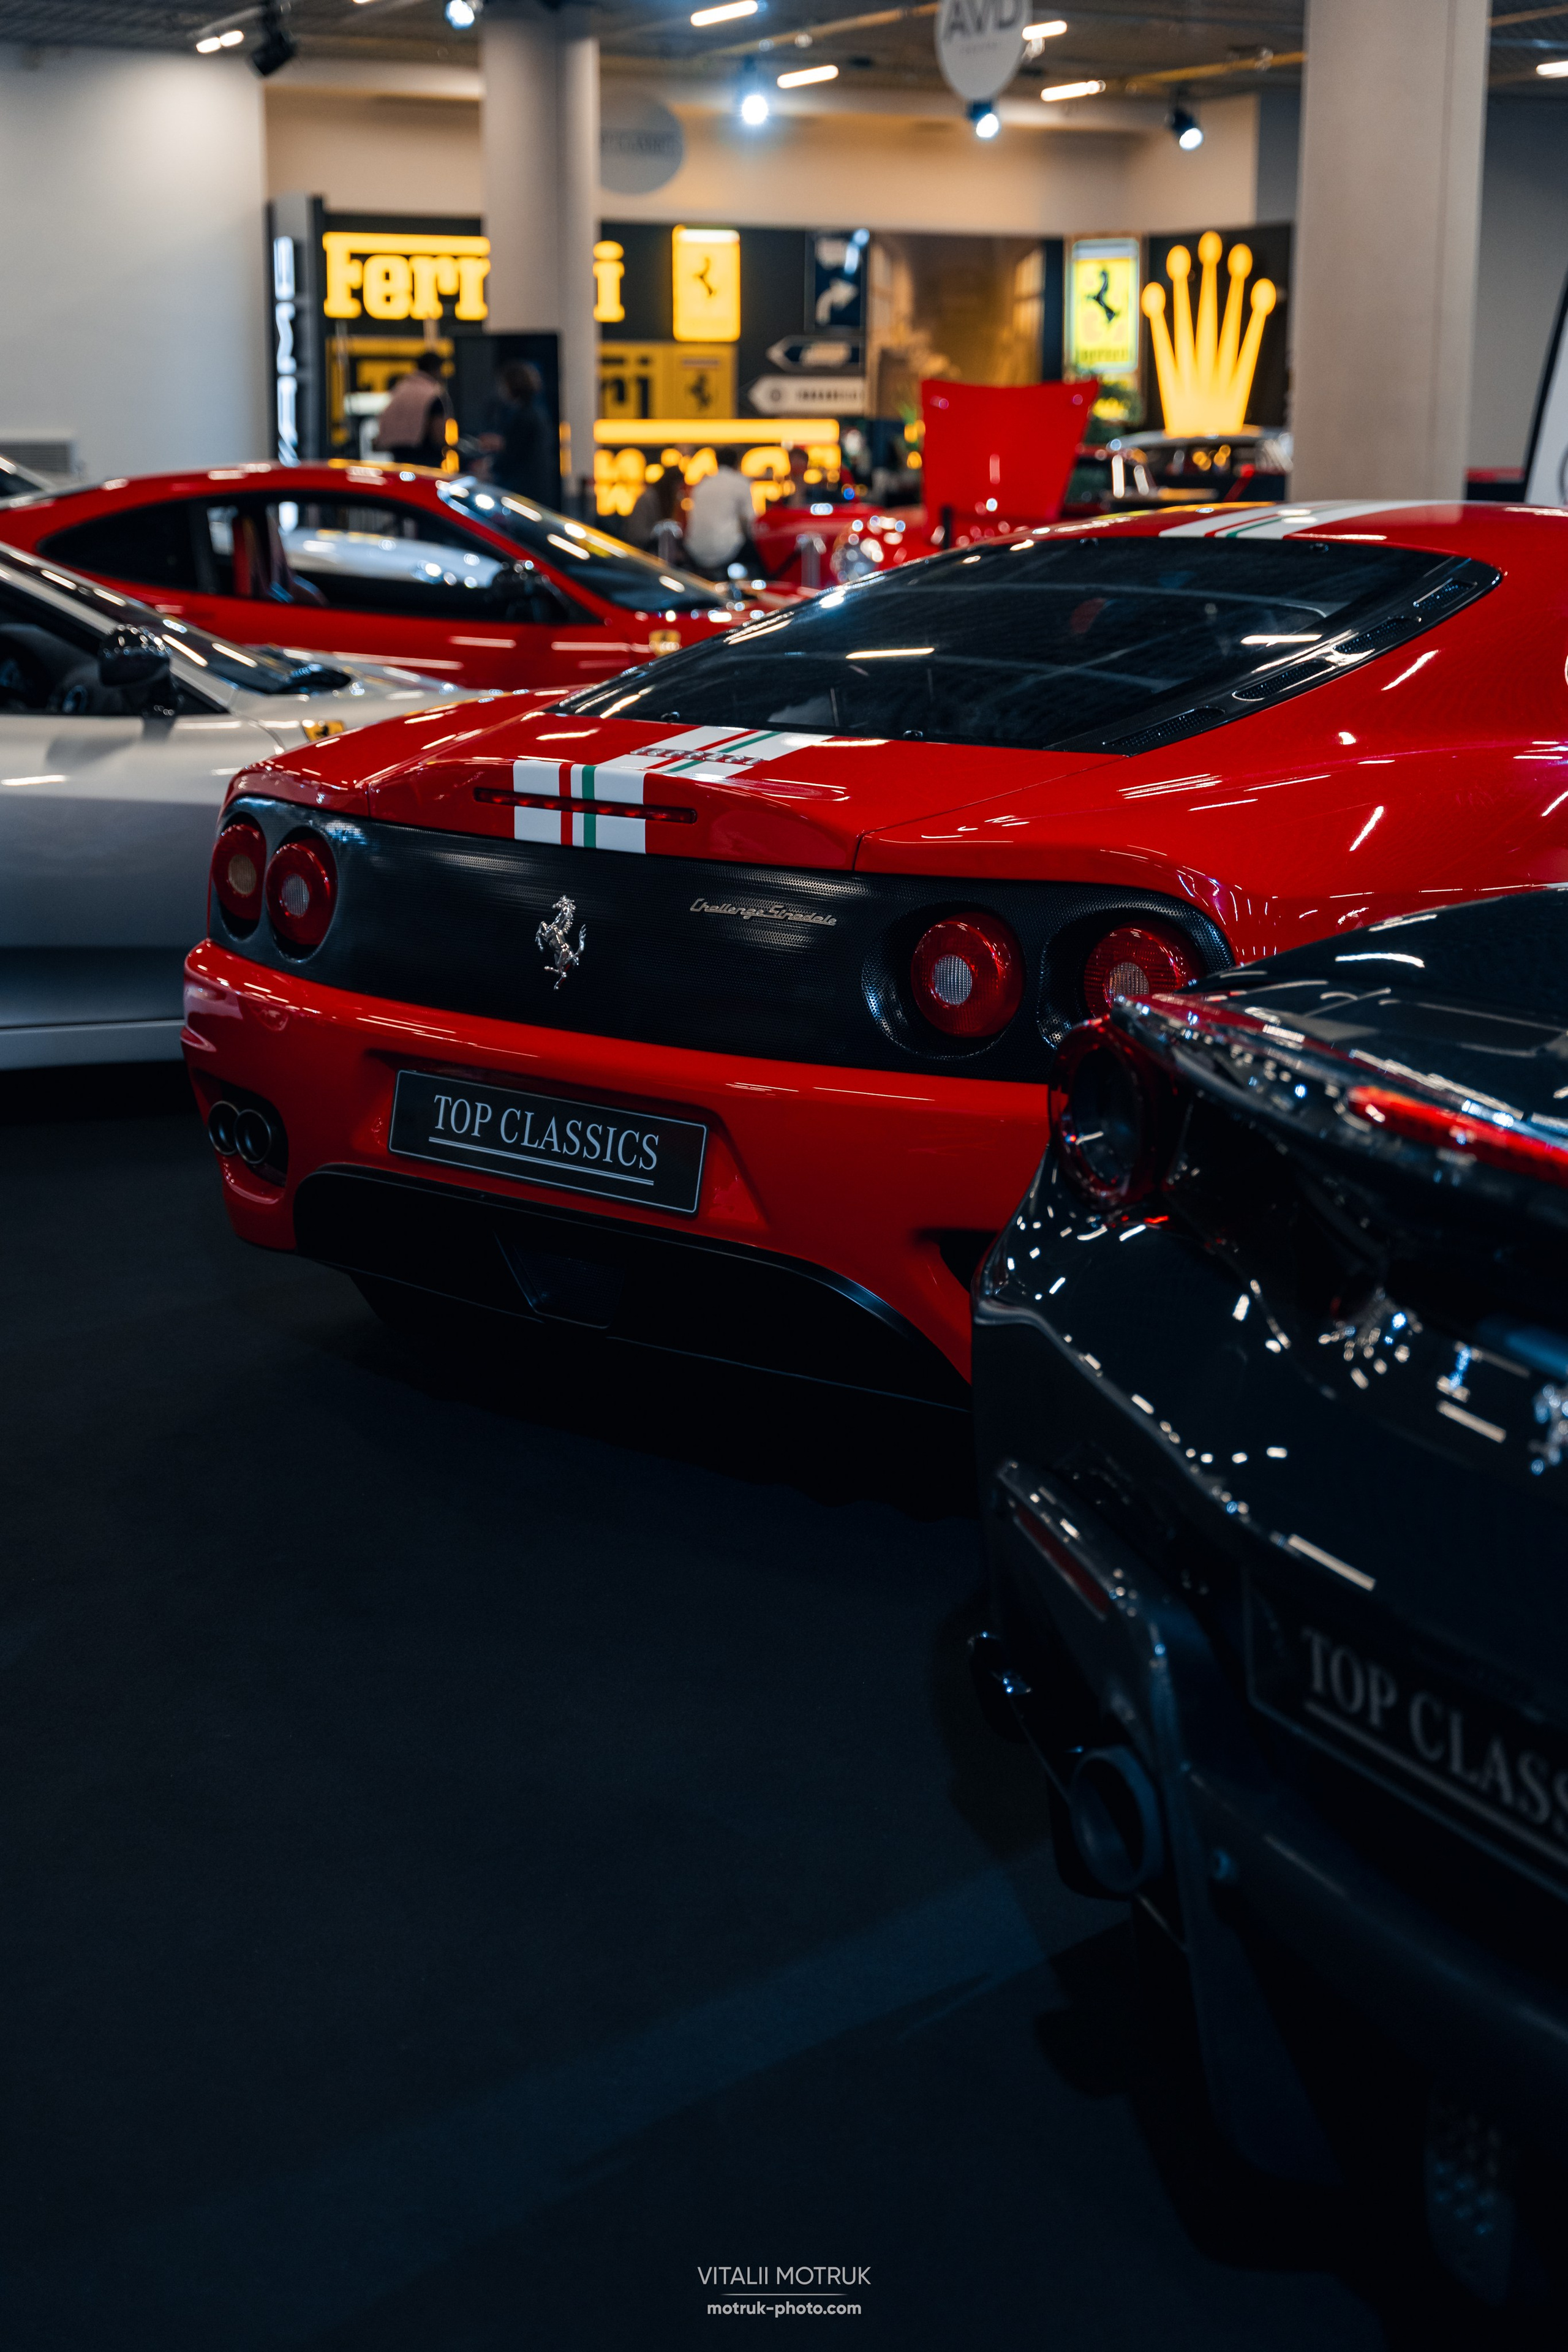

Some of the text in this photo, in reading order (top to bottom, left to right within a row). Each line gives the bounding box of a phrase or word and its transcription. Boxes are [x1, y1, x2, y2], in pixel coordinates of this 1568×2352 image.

[322, 231, 625, 320] Ferri
[690, 898, 837, 926] Challenge Stradale
[434, 1094, 660, 1170] TOP CLASSICS
[1301, 1625, 1399, 1727] TOP
